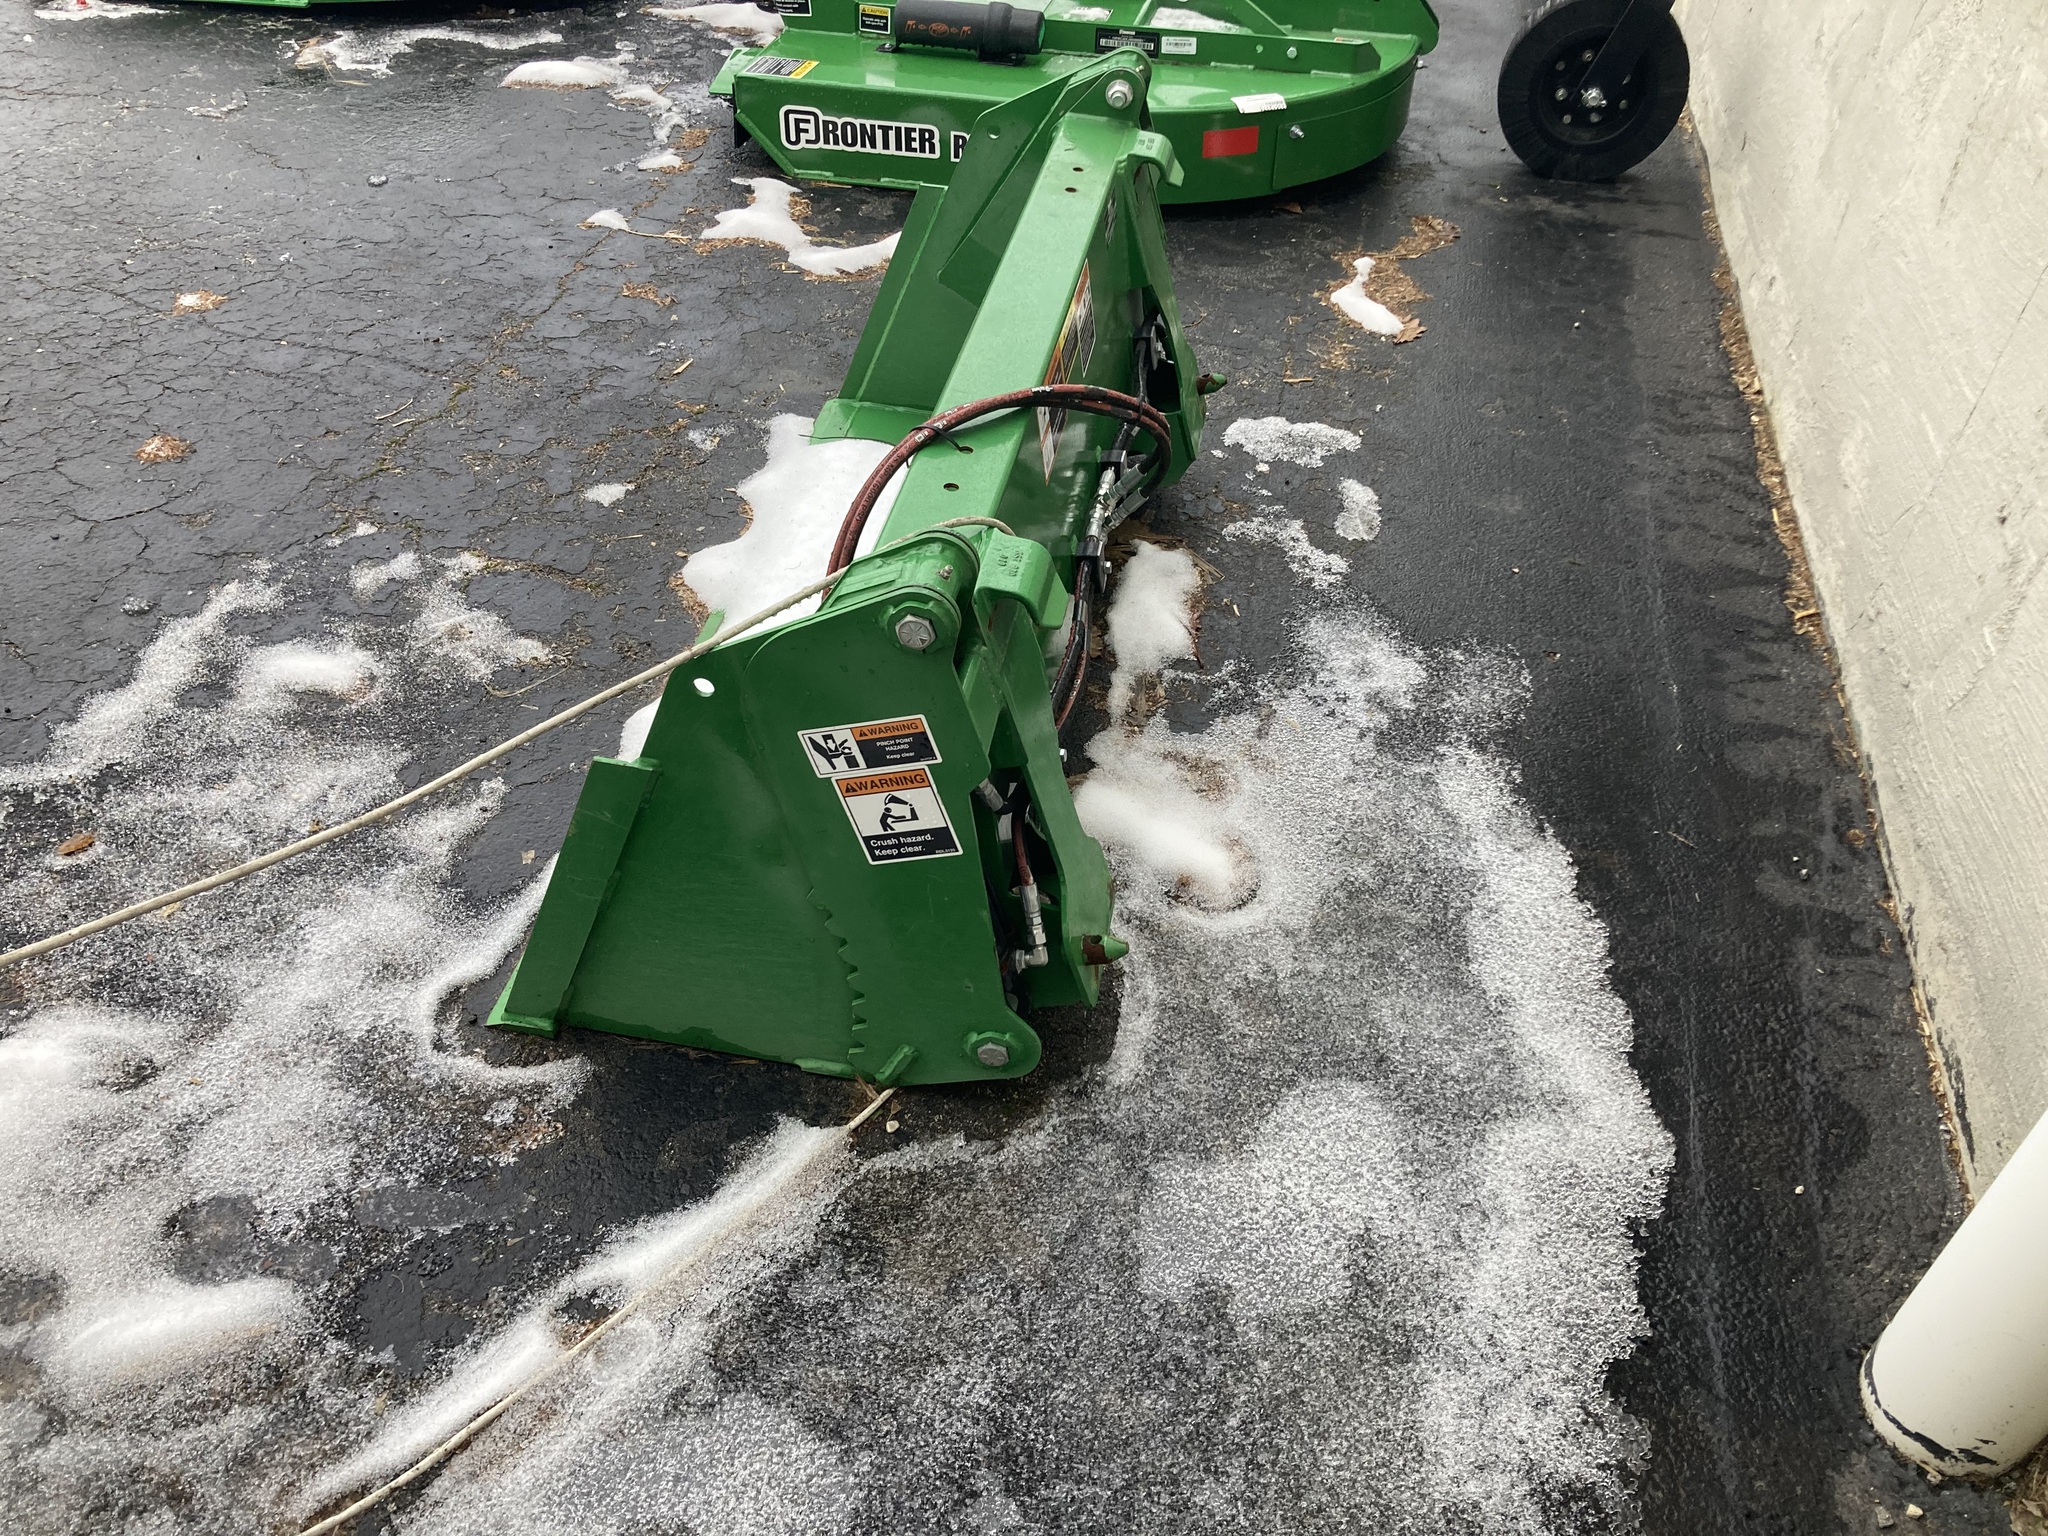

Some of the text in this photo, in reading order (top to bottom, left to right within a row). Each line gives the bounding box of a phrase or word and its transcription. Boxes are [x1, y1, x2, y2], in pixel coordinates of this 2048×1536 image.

[784, 109, 936, 155] FRONTIER
[867, 722, 919, 736] WARNING
[876, 739, 895, 747] PINCH
[885, 744, 910, 752] HAZARD
[854, 773, 926, 791] WARNING
[870, 833, 935, 847] Crush hazard.
[874, 848, 899, 856] Keep
[900, 845, 926, 854] clear.
